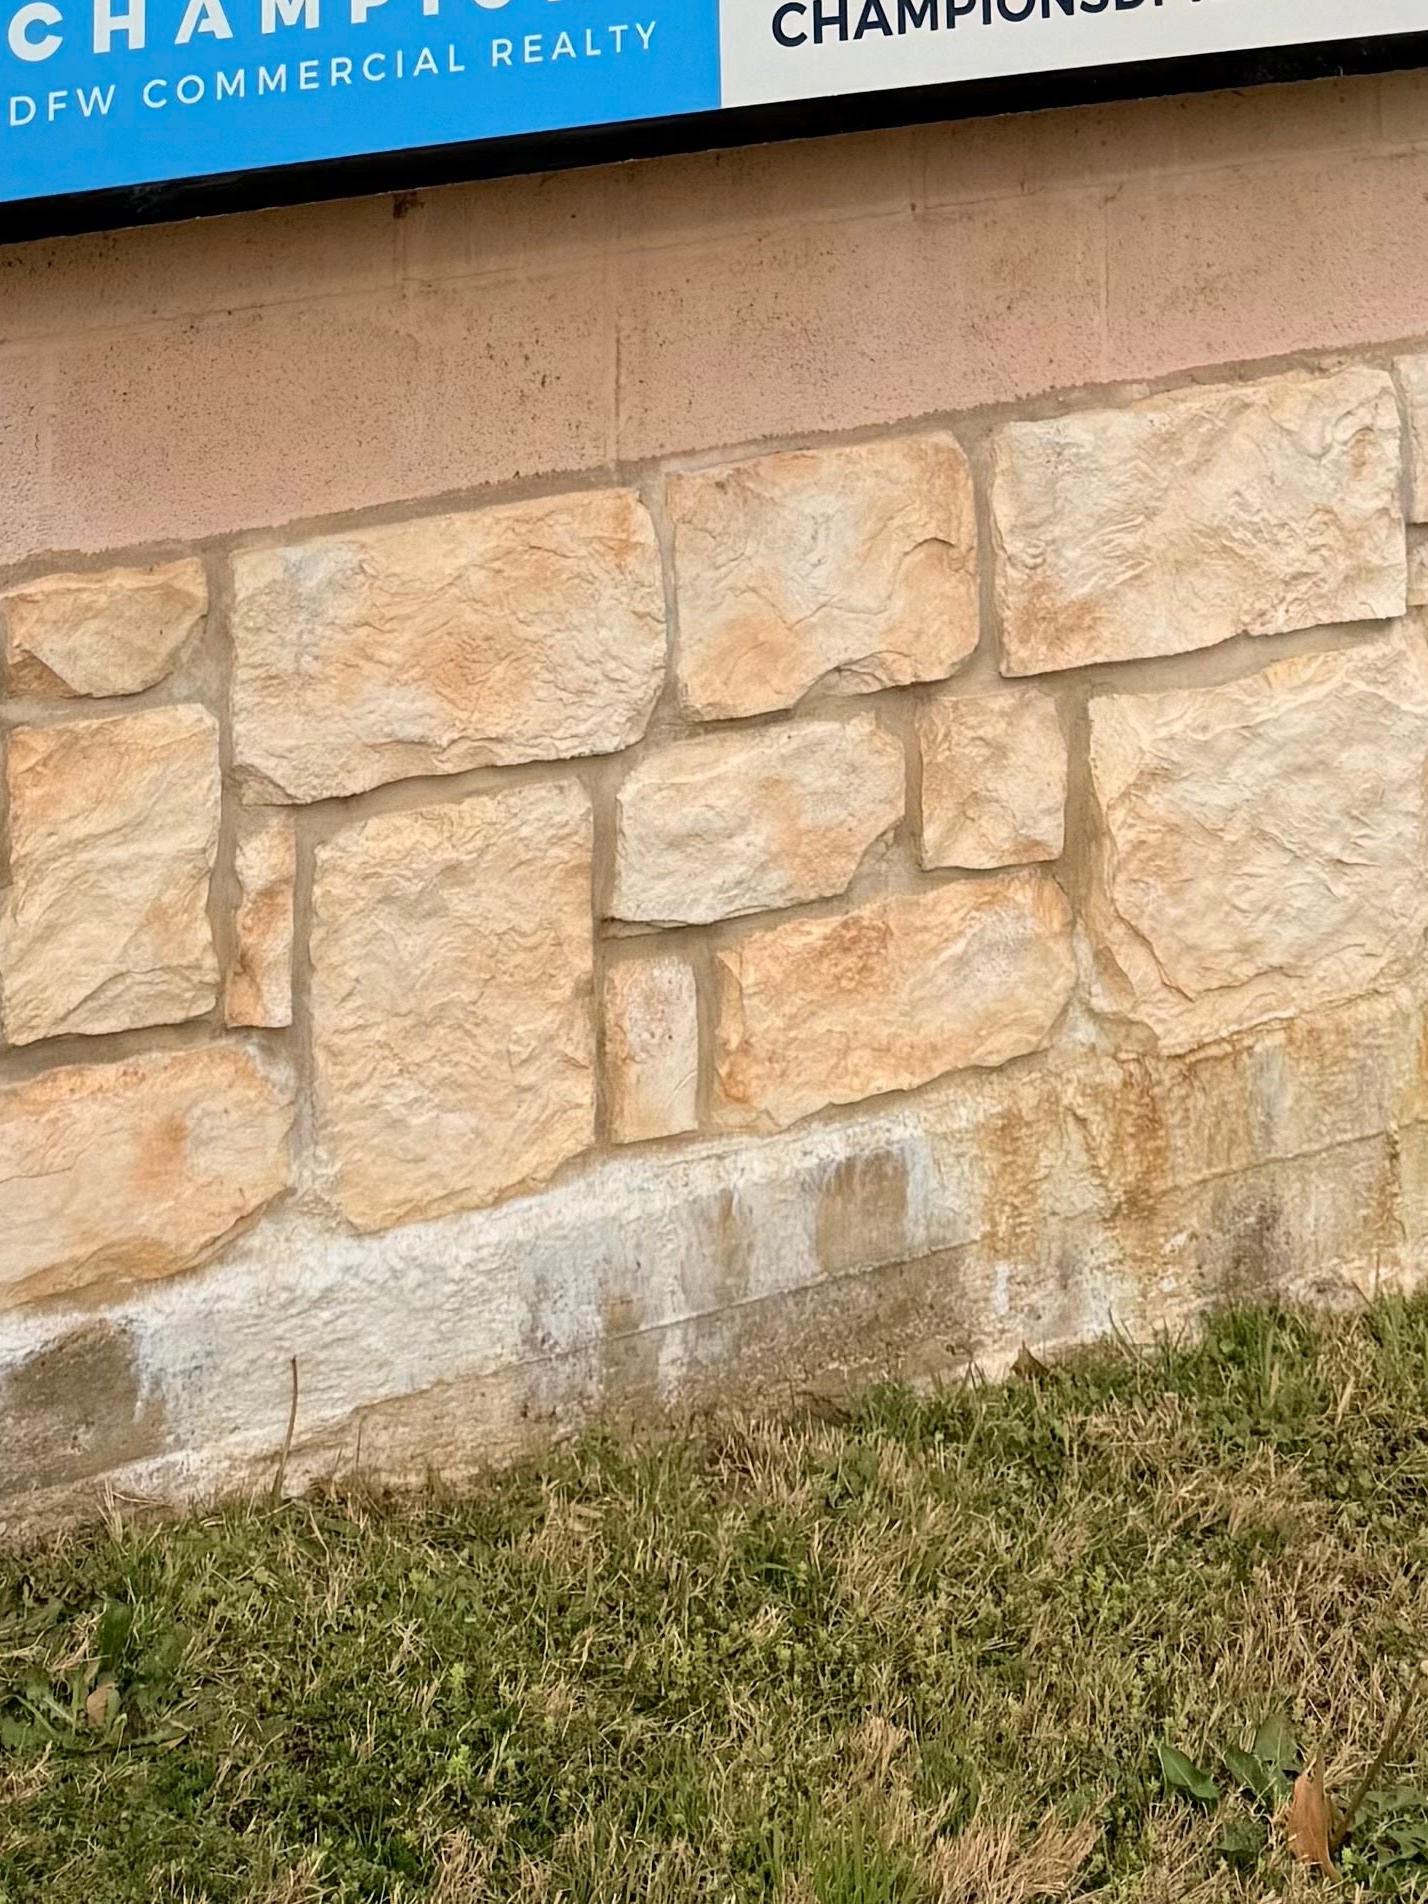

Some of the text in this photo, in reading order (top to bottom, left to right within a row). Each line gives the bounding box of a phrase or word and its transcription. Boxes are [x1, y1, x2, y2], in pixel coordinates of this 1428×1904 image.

[9, 20, 659, 127] DFW COMMERCIAL REALTY
